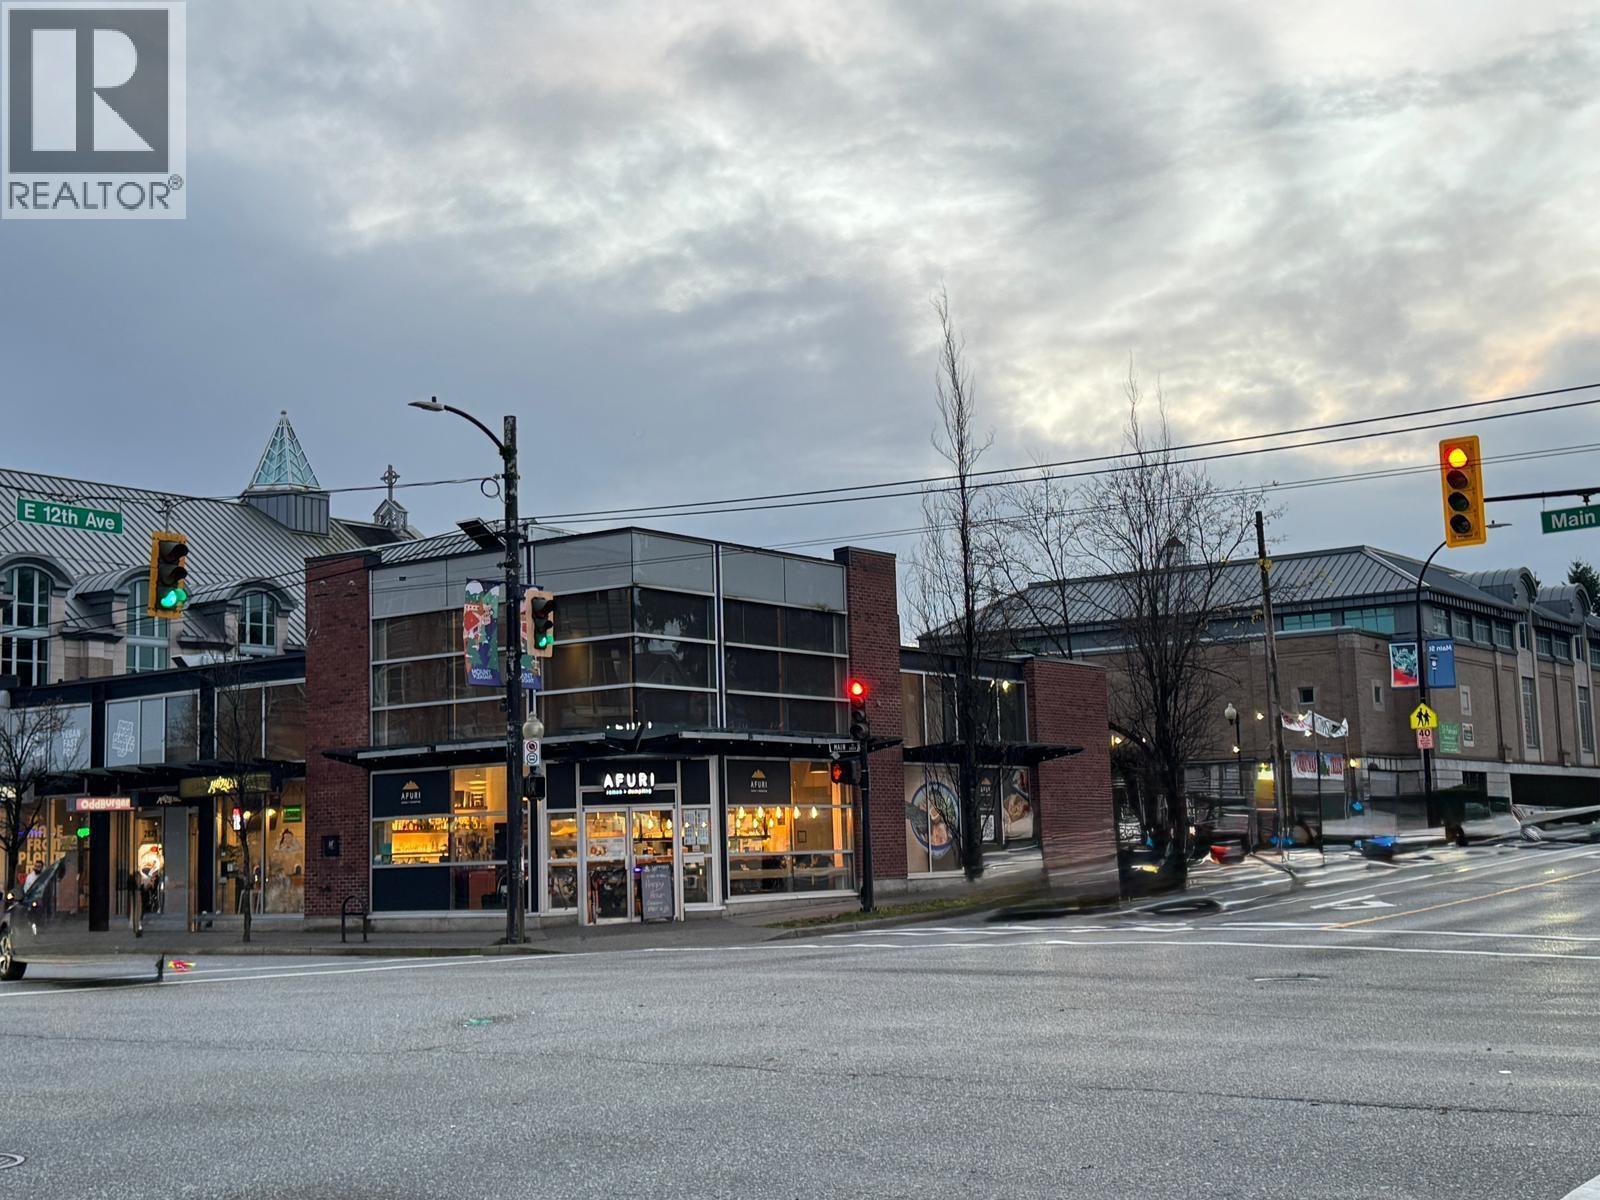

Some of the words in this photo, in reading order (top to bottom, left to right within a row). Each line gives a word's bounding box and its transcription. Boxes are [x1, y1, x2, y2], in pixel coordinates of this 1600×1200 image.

[24, 503, 36, 519] E
[43, 506, 79, 526] 12th
[85, 511, 115, 530] Ave
[1551, 511, 1596, 530] Main
[603, 771, 655, 788] AFURI
[751, 780, 768, 789] AFURI
[400, 791, 421, 801] AFURI
